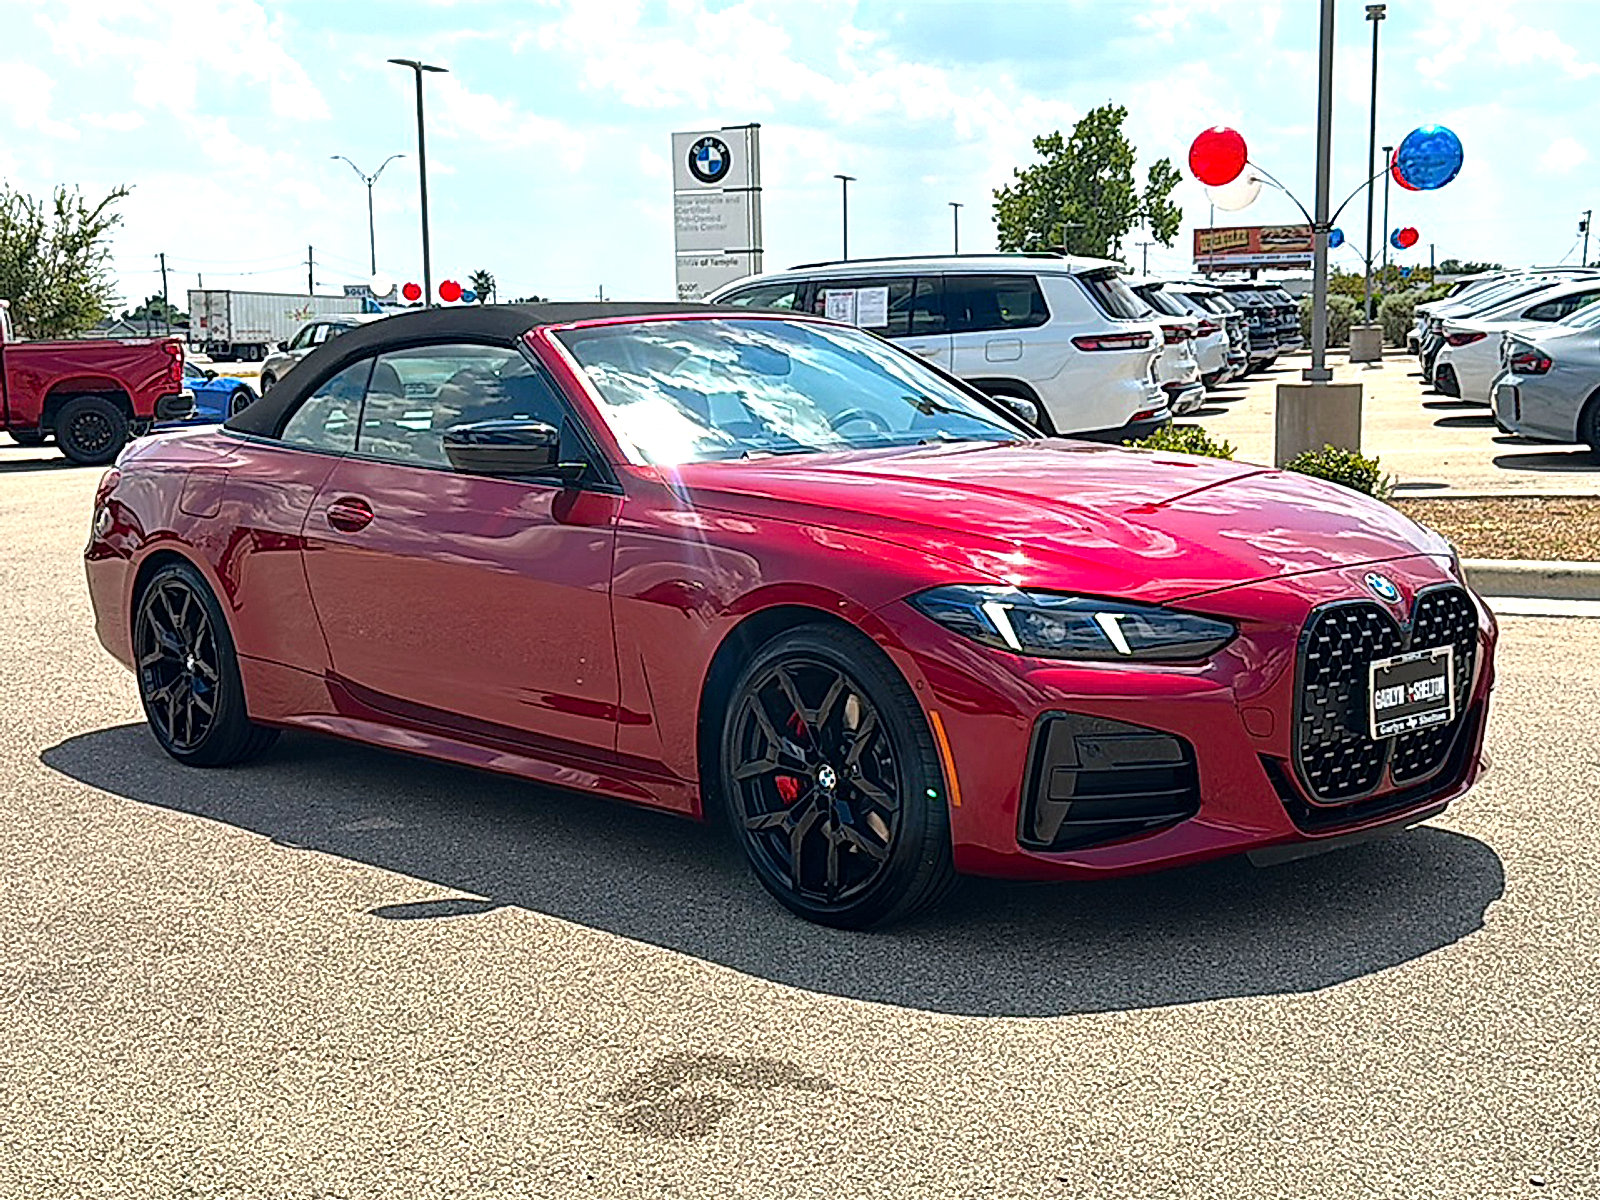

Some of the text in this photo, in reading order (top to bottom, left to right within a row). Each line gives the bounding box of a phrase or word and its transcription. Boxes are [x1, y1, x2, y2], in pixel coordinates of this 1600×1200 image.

[725, 196, 740, 204] and
[675, 206, 711, 214] Certified
[675, 214, 722, 223] Pre-Owned
[700, 223, 727, 232] Center
[710, 257, 739, 268] Temple
[1413, 675, 1446, 702] SHELTON
